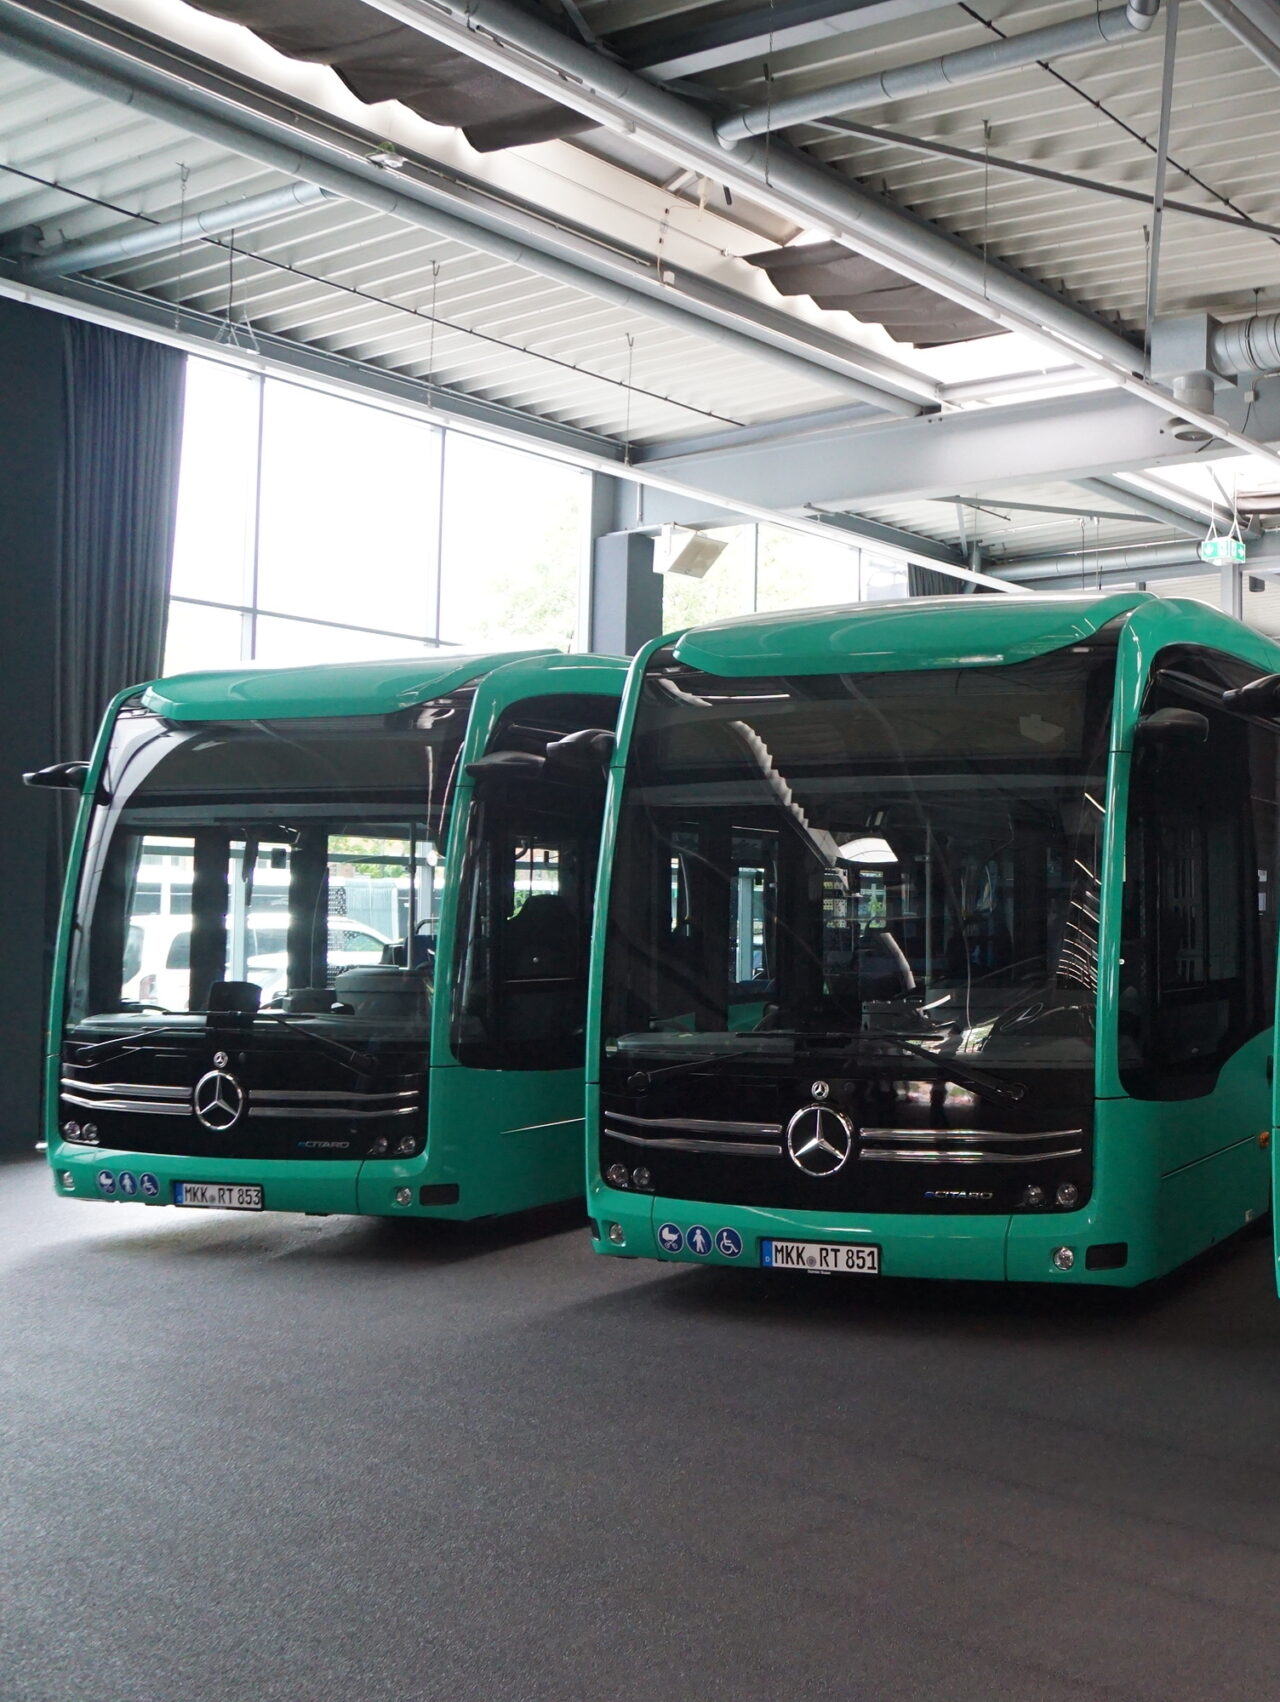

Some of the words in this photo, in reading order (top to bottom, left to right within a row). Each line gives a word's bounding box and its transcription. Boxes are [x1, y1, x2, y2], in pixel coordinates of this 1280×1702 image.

[184, 1186, 208, 1203] MKK
[217, 1187, 234, 1204] RT
[237, 1189, 261, 1205] 853
[774, 1244, 806, 1266] MKK
[820, 1247, 841, 1268] RT
[845, 1249, 877, 1270] 851
